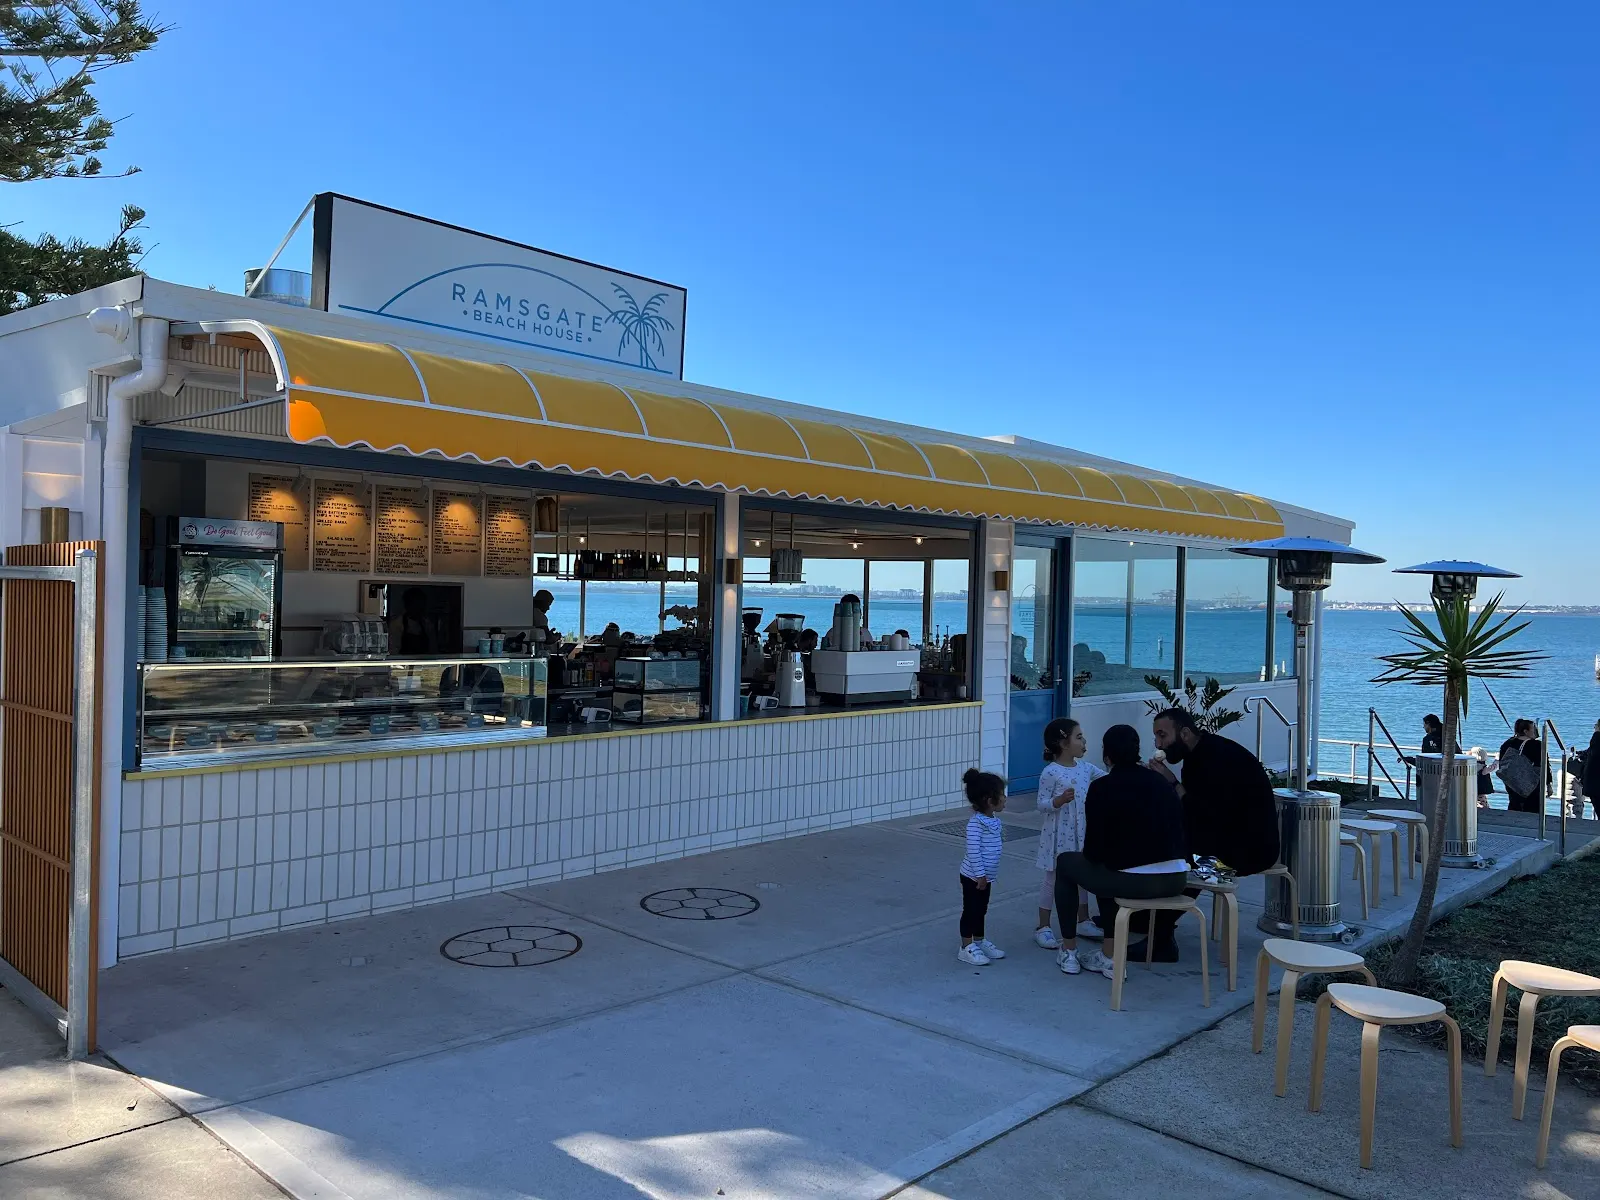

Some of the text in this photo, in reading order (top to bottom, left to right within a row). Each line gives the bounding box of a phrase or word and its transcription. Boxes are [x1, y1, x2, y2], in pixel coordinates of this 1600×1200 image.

[452, 282, 603, 333] RAMSGATE
[473, 309, 583, 343] BEACH HOUSE
